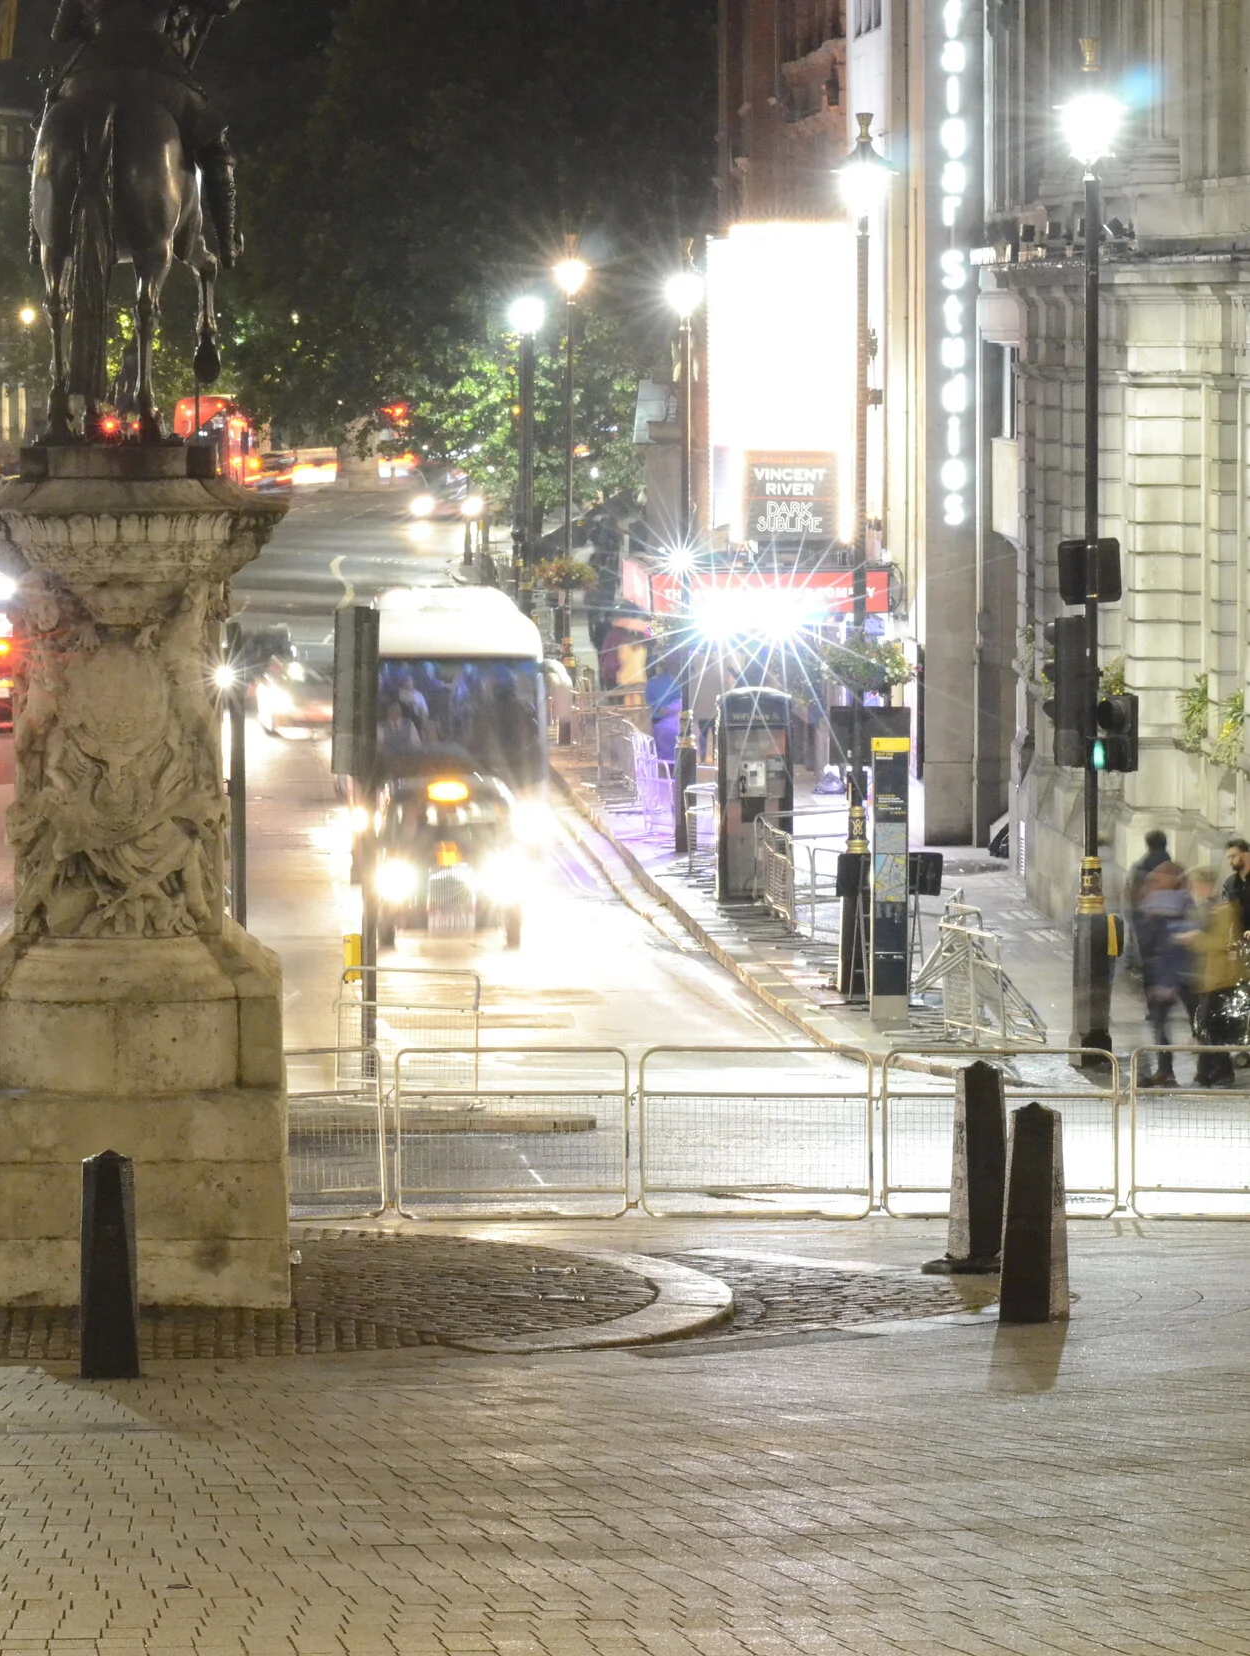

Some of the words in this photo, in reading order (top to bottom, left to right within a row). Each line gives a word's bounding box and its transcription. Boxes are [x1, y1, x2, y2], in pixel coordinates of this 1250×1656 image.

[754, 468, 827, 481] VINCENT
[765, 483, 815, 496] RIVER
[766, 501, 813, 517] DARK
[756, 516, 823, 533] SUBLIME
